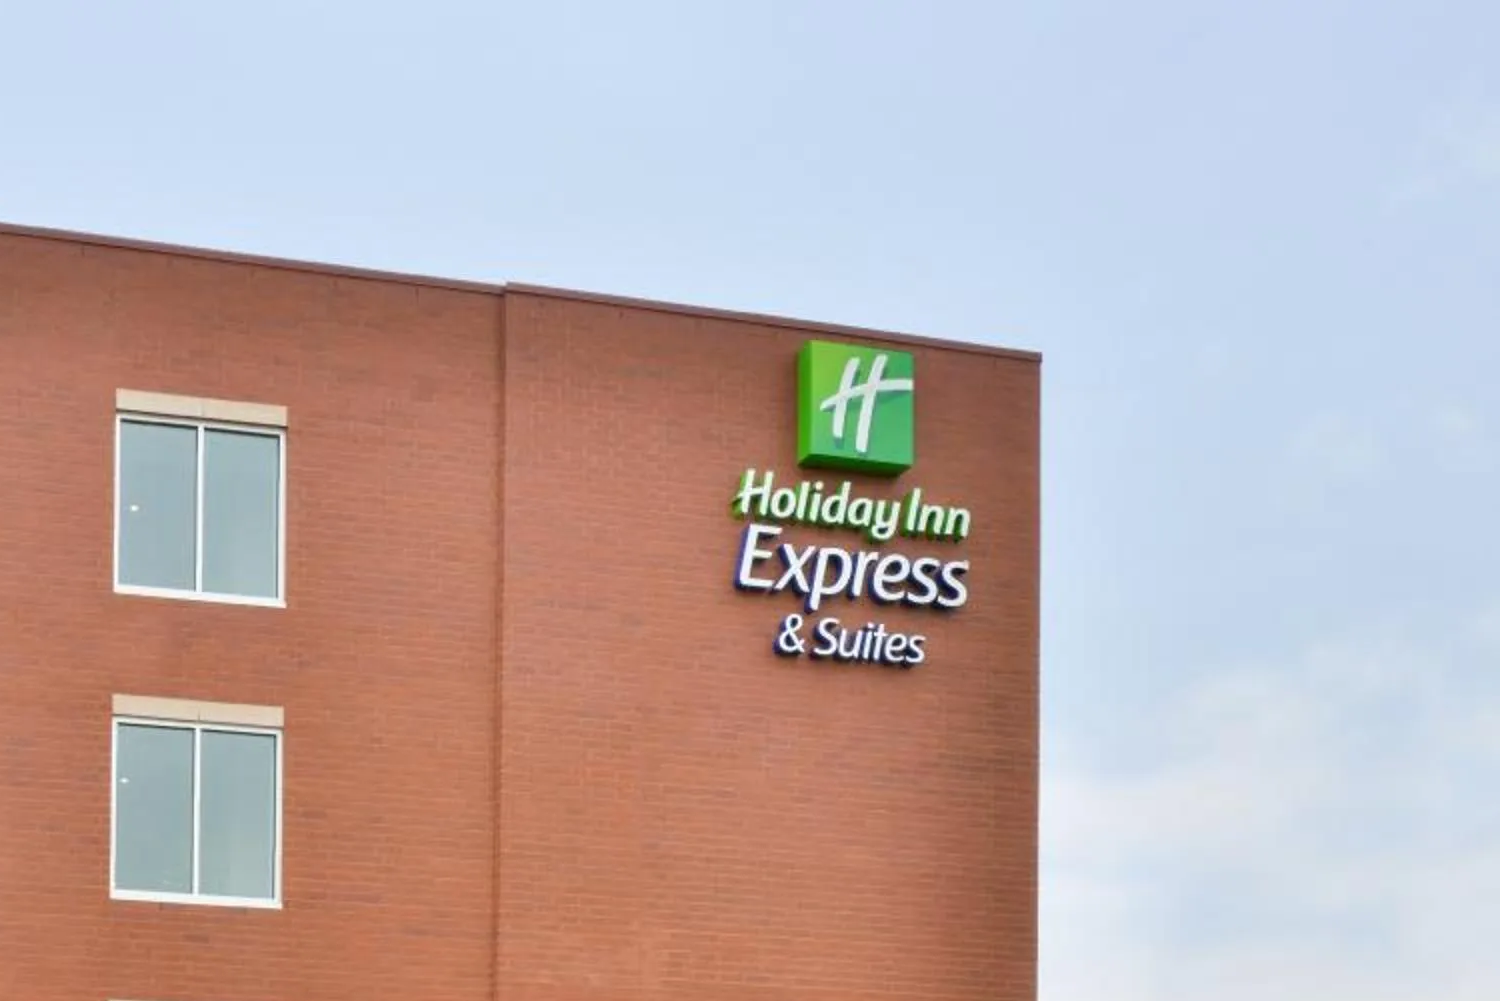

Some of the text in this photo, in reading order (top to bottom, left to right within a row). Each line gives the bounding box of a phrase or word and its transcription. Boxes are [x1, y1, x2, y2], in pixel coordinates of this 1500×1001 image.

[733, 467, 971, 541] Holiday Inn
[736, 522, 970, 612] Express
[777, 613, 926, 665] & Suites
